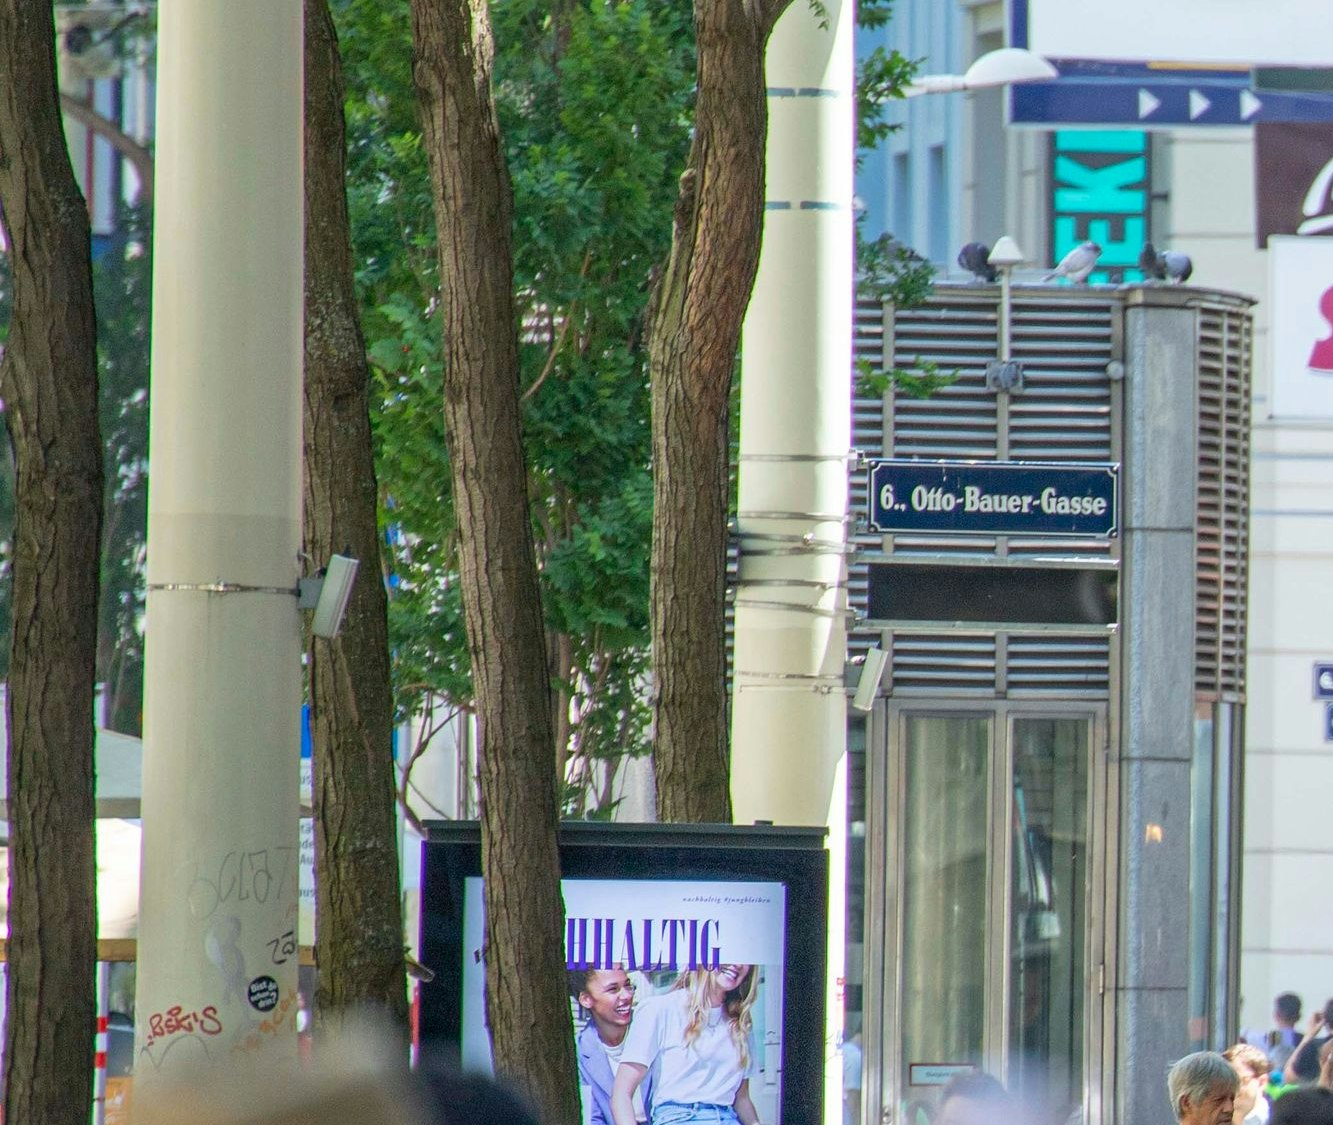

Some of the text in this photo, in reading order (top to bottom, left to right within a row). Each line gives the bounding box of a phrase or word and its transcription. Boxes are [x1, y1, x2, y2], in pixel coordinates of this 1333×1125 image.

[880, 484, 1107, 515] 6., Otto-Bauer-Gasse
[567, 918, 721, 972] HHALTIG
